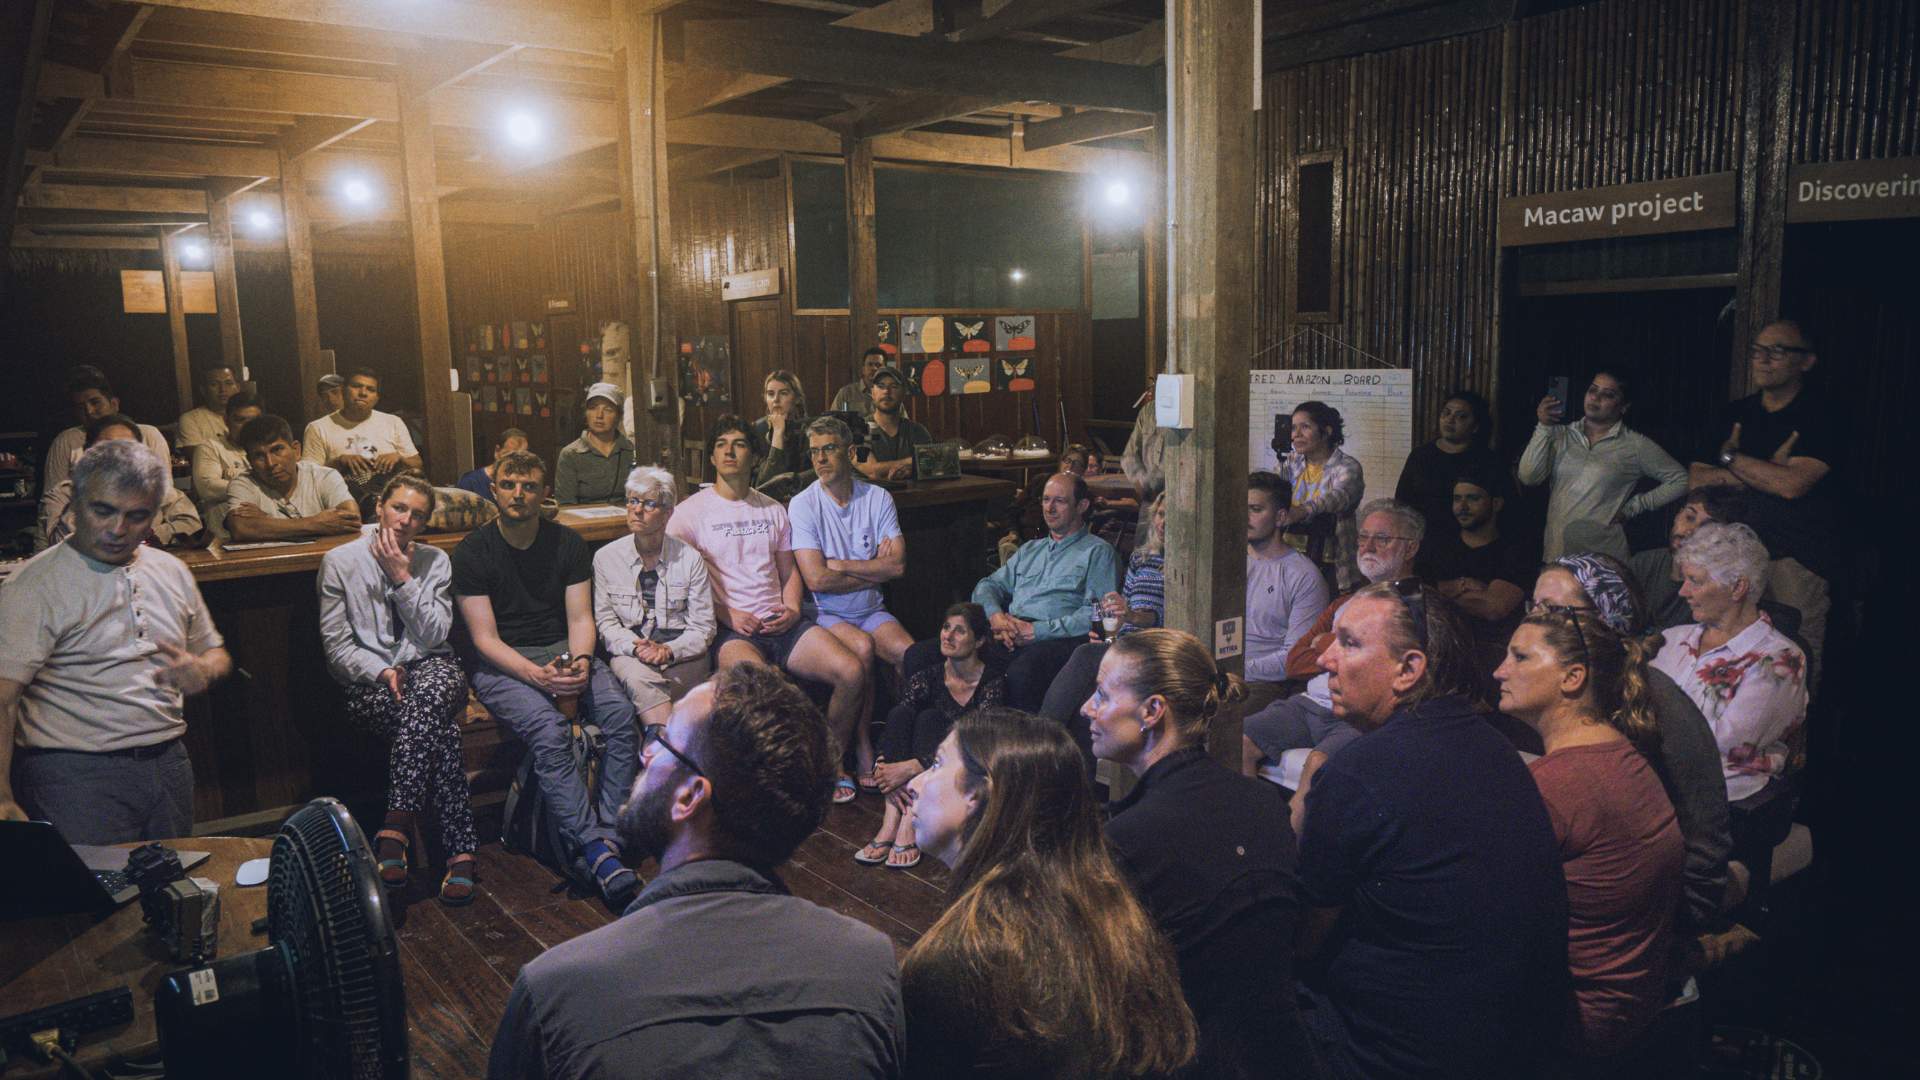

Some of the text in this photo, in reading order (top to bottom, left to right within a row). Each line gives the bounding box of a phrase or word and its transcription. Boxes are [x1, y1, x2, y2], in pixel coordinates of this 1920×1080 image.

[1798, 173, 1920, 202] Discoverin
[1524, 191, 1704, 227] Macaw project
[1287, 374, 1331, 385] AMAZON
[1344, 373, 1382, 385] BOARD
